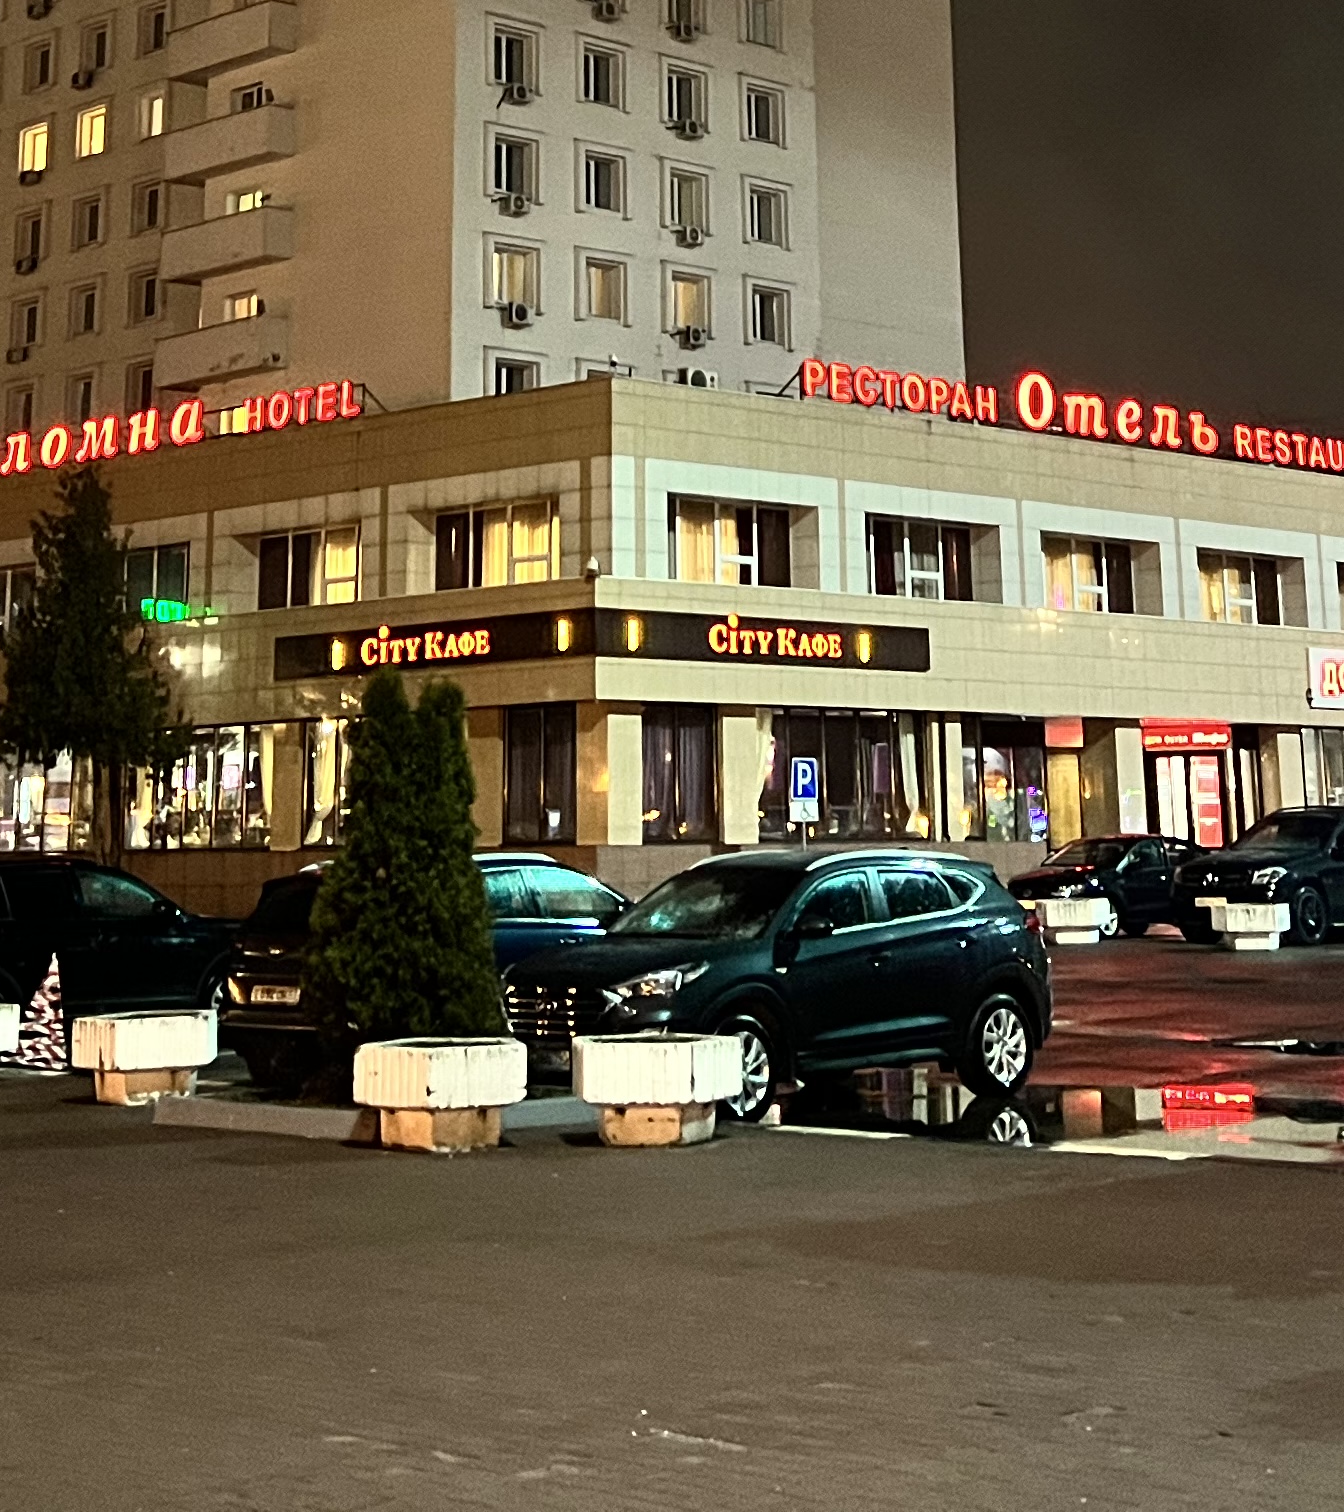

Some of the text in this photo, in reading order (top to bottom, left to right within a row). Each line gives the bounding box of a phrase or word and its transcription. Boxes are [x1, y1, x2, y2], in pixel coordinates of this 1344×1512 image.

[243, 380, 360, 433] HOTEL
[803, 359, 998, 423] РЕСТОРАН
[1016, 371, 1219, 454] Отель
[797, 762, 812, 796] P
